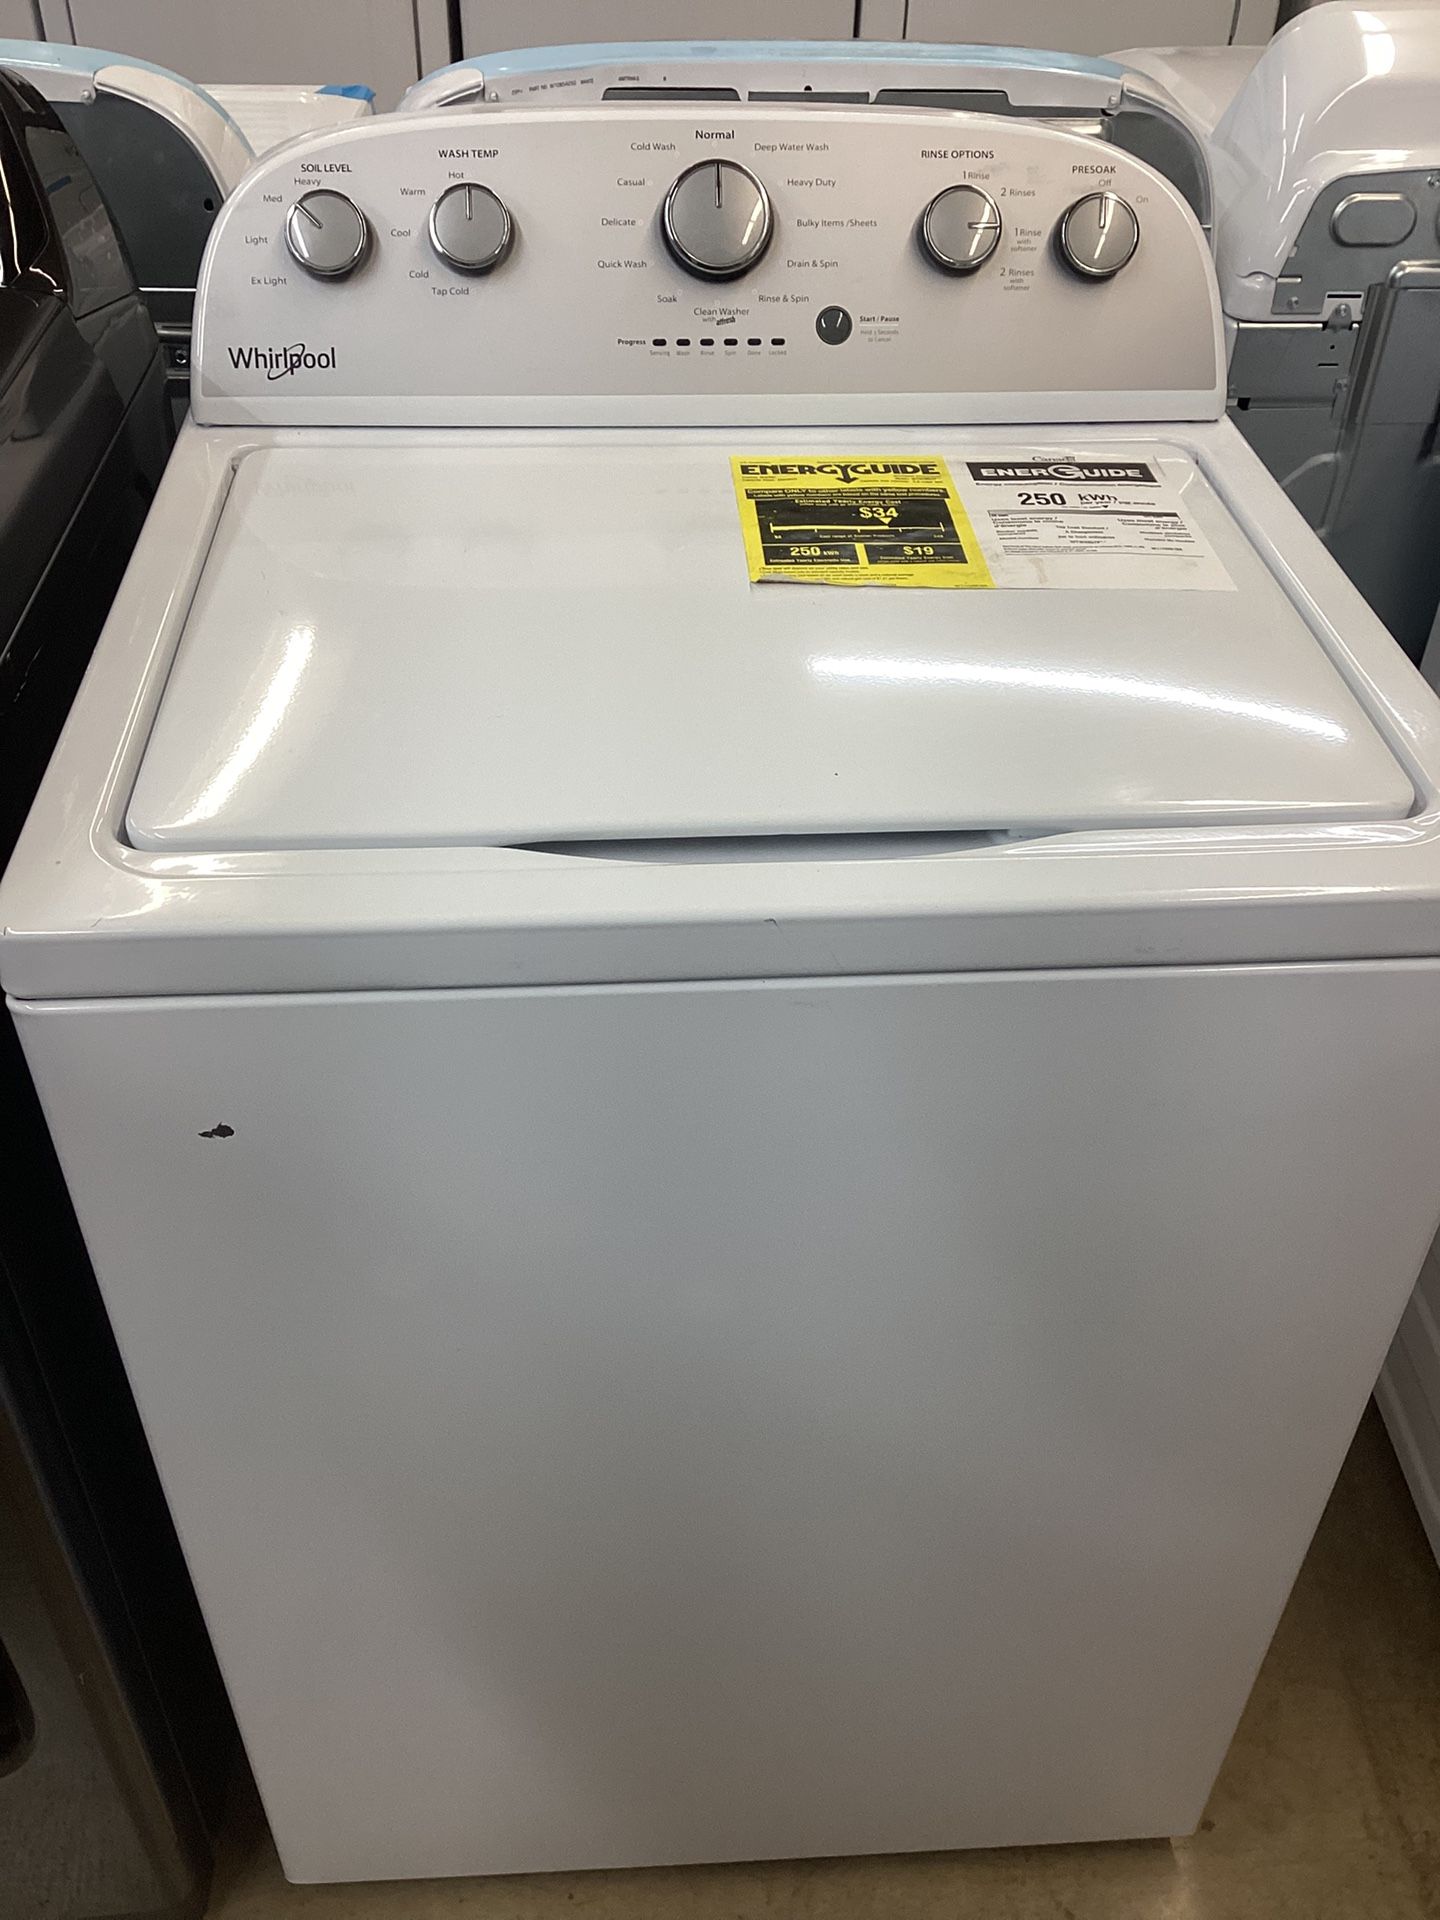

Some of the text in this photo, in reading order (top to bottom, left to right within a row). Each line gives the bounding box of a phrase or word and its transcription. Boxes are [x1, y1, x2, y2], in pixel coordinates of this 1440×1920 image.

[695, 130, 735, 140] Normal
[631, 143, 676, 151] Cold Wash
[754, 143, 829, 152] Deep Water Wash
[439, 150, 499, 158] WASH TEMP
[922, 150, 994, 159] RINSE OPTIONS
[301, 164, 352, 173] SOIL LEVEL
[1072, 166, 1116, 174] PRESOAK
[449, 171, 464, 179] Hot
[963, 171, 966, 179] 1
[295, 177, 321, 187] Heavy
[617, 178, 645, 186] Casual
[787, 178, 836, 188] Heavy Duty
[1099, 179, 1112, 187] Off
[400, 187, 426, 196] Warm
[1001, 188, 1036, 197] 2 Rinses
[263, 194, 283, 203] Med
[1136, 196, 1149, 204] On
[602, 218, 636, 226] Delicate
[797, 219, 819, 229] Bulky
[822, 219, 844, 227] Items
[391, 229, 411, 237] Cool
[1015, 228, 1042, 237] 1 Rinse
[245, 235, 268, 245] Light
[598, 260, 647, 269] Quick Wash
[787, 260, 838, 270] Drain & Spin
[409, 270, 429, 279] Cold
[1000, 268, 1034, 277] 2 Rinses
[252, 276, 287, 287] Ex Light
[432, 287, 469, 296] Tap Cold
[657, 295, 677, 303] Soak
[758, 294, 810, 304] Rinse & Spin
[694, 308, 750, 316] Clean Washer
[228, 343, 337, 379] Whirlpool
[740, 464, 941, 479] ENERGYGUIDE
[980, 464, 1143, 480] ENERGUIDE
[1018, 493, 1118, 506] 250 kWh
[859, 506, 899, 519] $34
[790, 546, 821, 556] 250
[903, 546, 934, 556] $19
